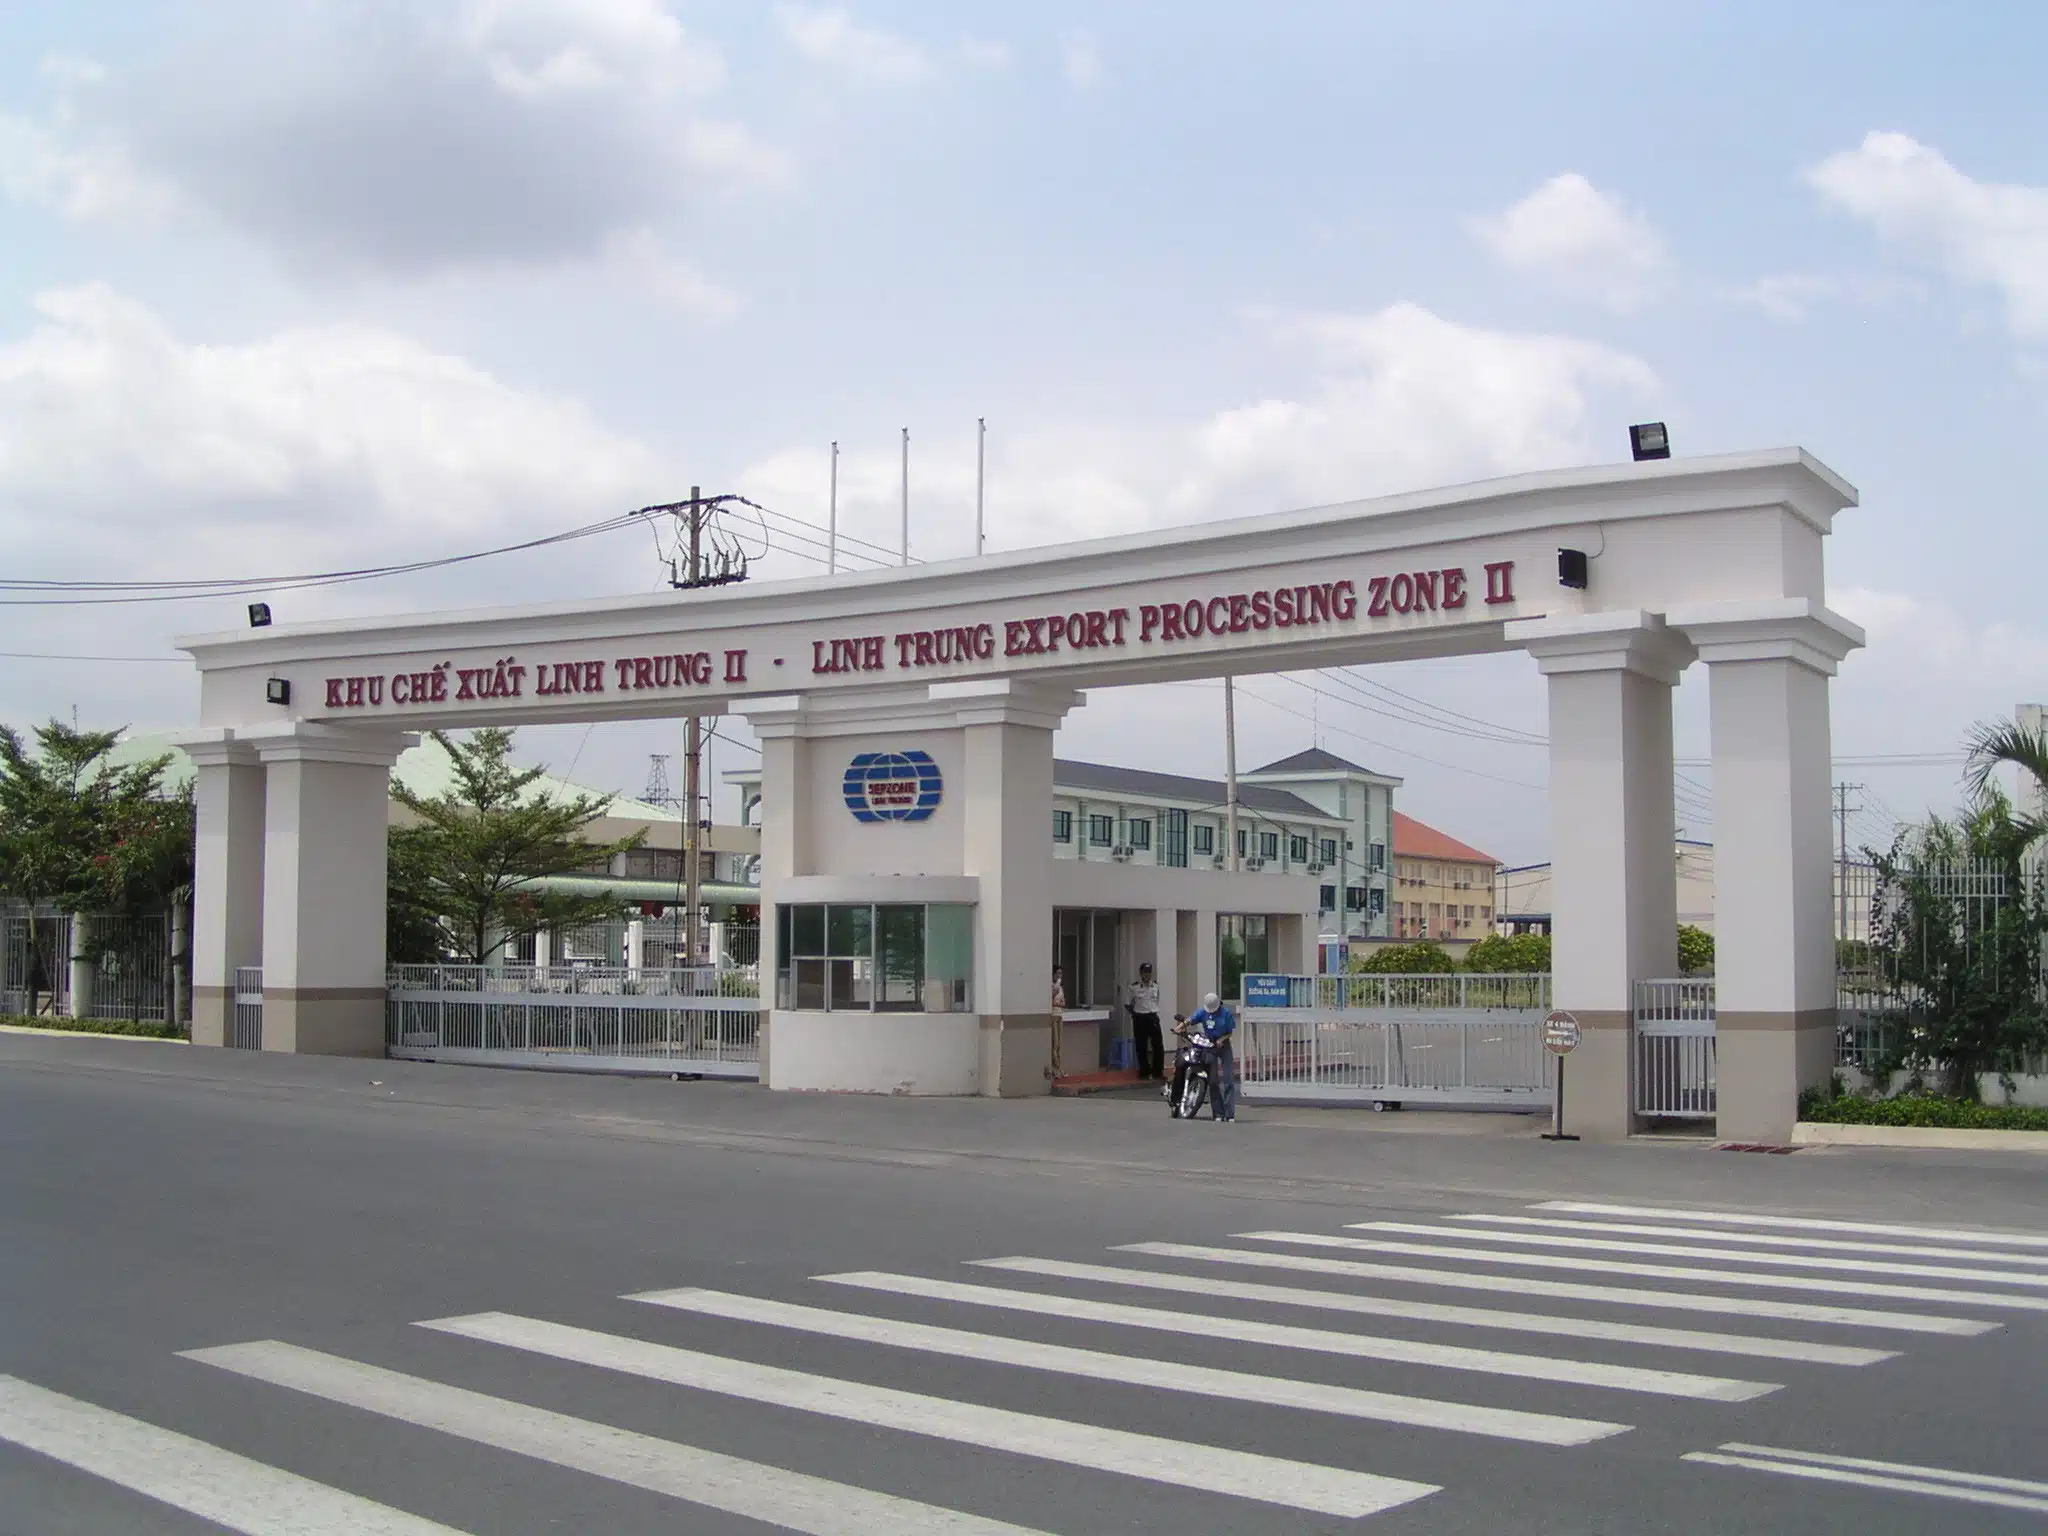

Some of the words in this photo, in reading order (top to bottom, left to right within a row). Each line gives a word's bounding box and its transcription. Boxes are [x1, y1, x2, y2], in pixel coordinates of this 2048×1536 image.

[325, 675, 385, 708] KHU
[391, 660, 452, 705] CHẾ
[455, 656, 527, 700] XUẤT
[536, 661, 606, 696] LINH
[614, 651, 713, 689] TRUNG
[723, 649, 748, 683] II
[811, 635, 886, 674] LINH
[894, 623, 995, 668] TRUNG
[1003, 607, 1131, 657] EXPORT
[1139, 579, 1357, 642] PROCESSING
[1367, 566, 1468, 617] ZONE
[1483, 560, 1515, 604] II
